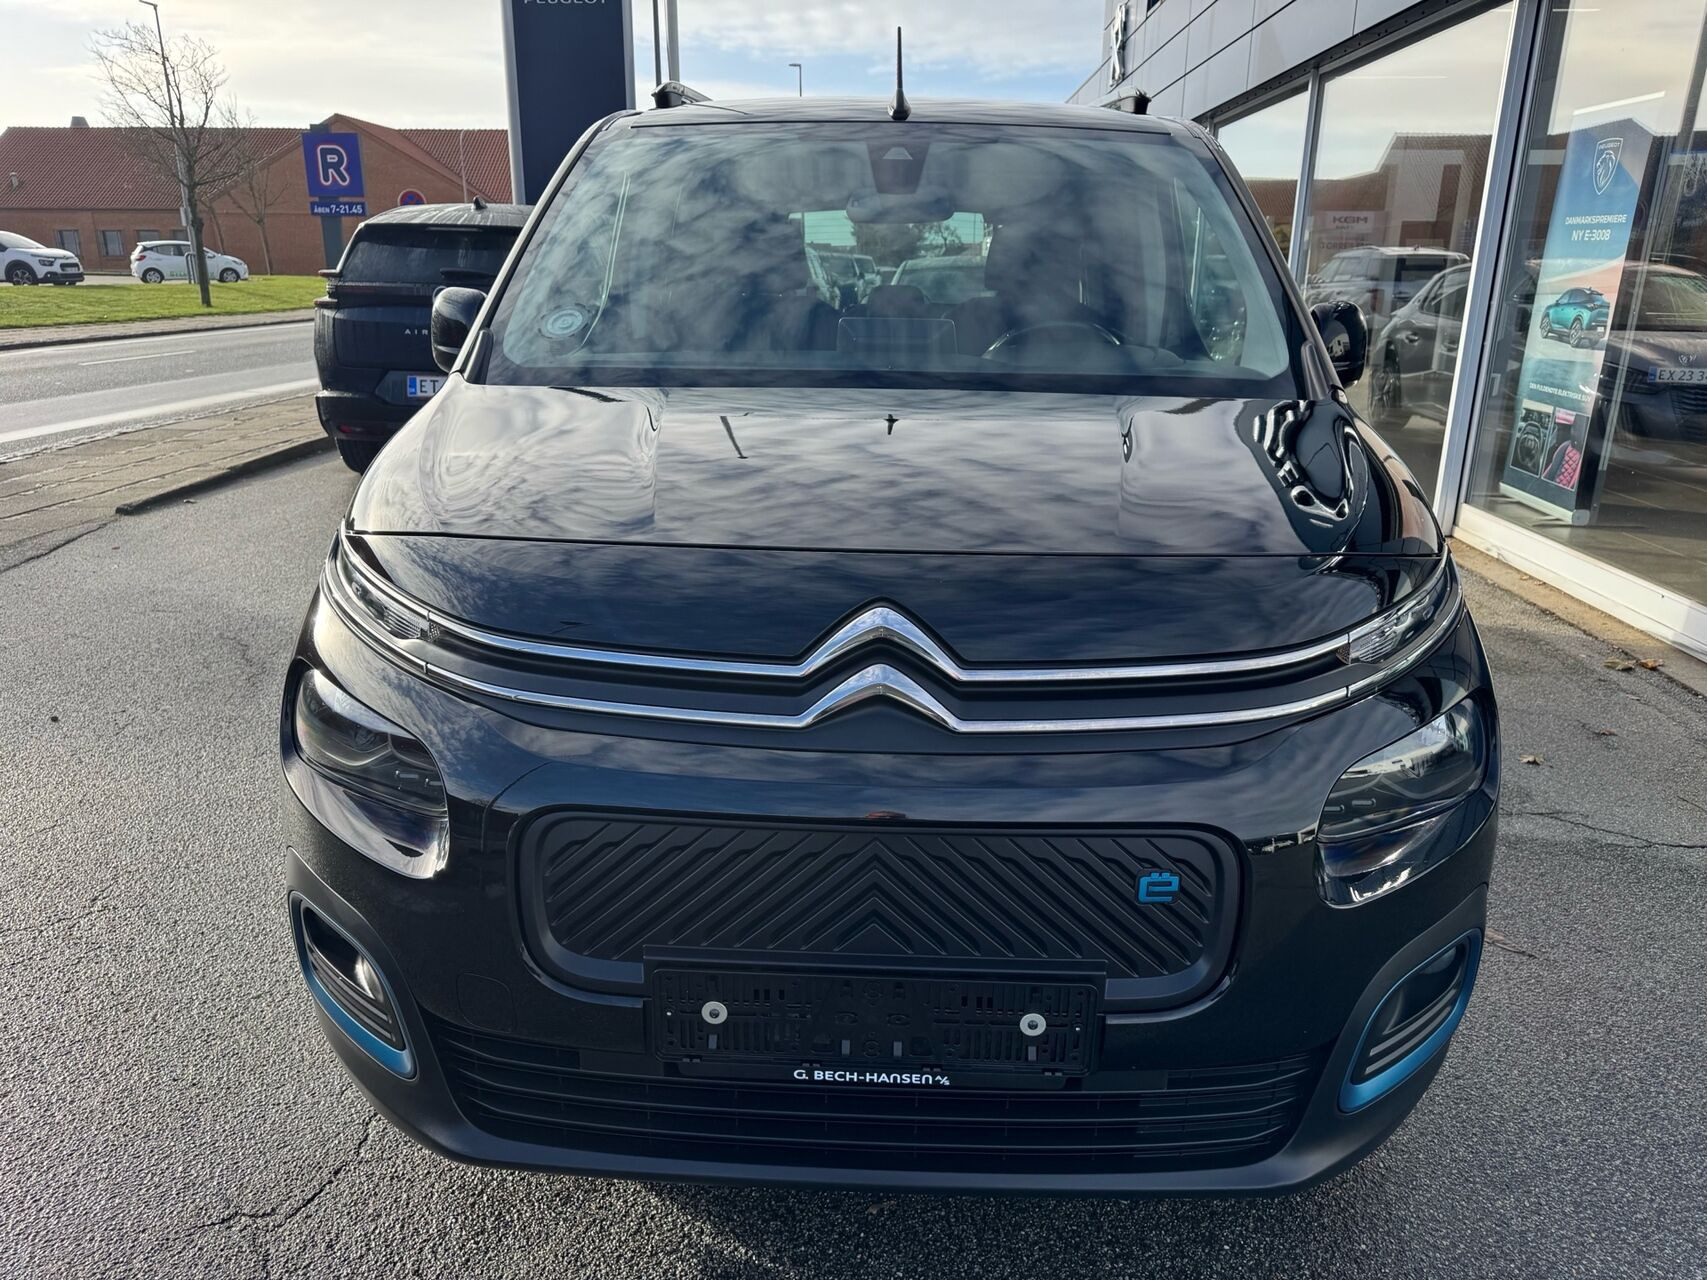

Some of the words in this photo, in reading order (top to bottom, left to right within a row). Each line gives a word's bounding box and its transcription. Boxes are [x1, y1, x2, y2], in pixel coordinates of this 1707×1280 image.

[317, 145, 350, 186] R
[330, 205, 363, 213] 7-21.45
[1565, 214, 1628, 225] DANMARKSPREMIERE
[1571, 229, 1584, 241] NY
[1584, 229, 1611, 241] E-3008
[1658, 369, 1676, 381] EX
[1678, 370, 1694, 381] 23
[420, 380, 439, 394] ET
[793, 1069, 809, 1080] G.
[814, 1070, 933, 1085] BECH-HANSEN
